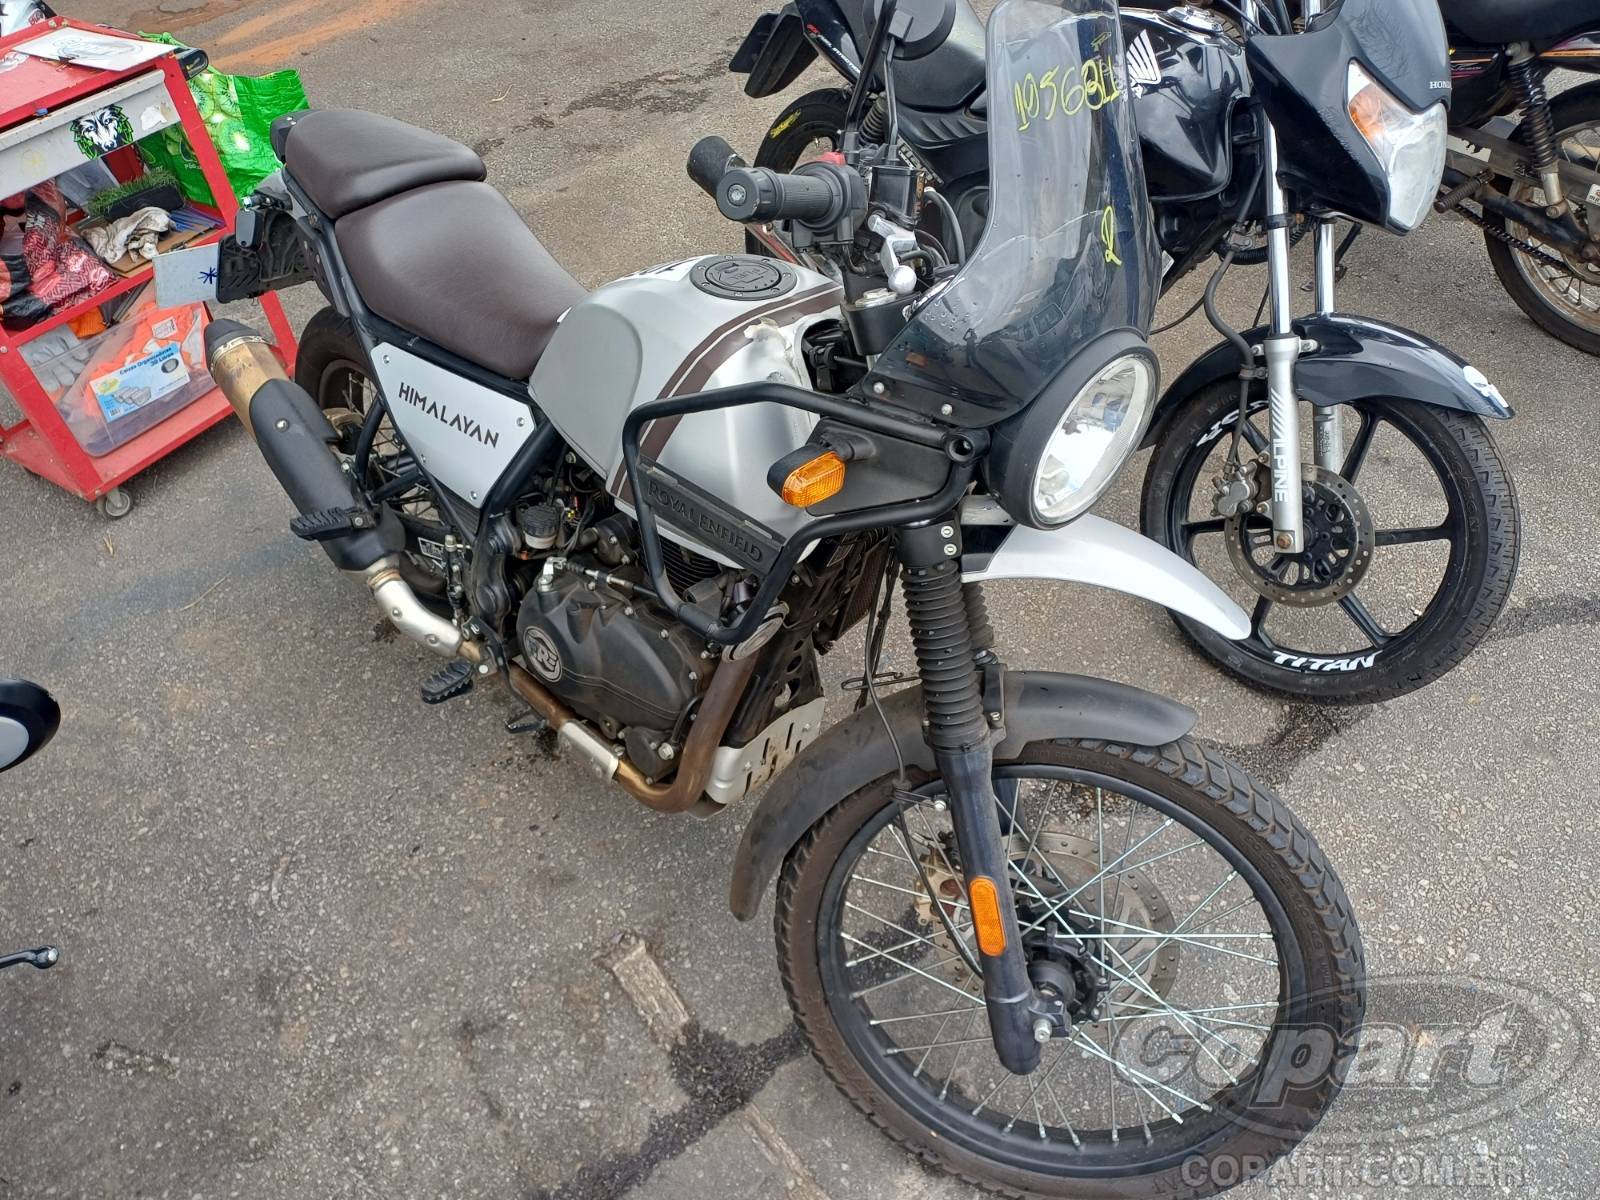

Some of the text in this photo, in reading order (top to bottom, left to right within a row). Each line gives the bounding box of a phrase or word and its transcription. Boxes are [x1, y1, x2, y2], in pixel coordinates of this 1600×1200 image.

[398, 382, 500, 449] HIMALAYAN
[647, 481, 764, 563] ROYAL ENFIELD
[1271, 649, 1384, 672] TITAN
